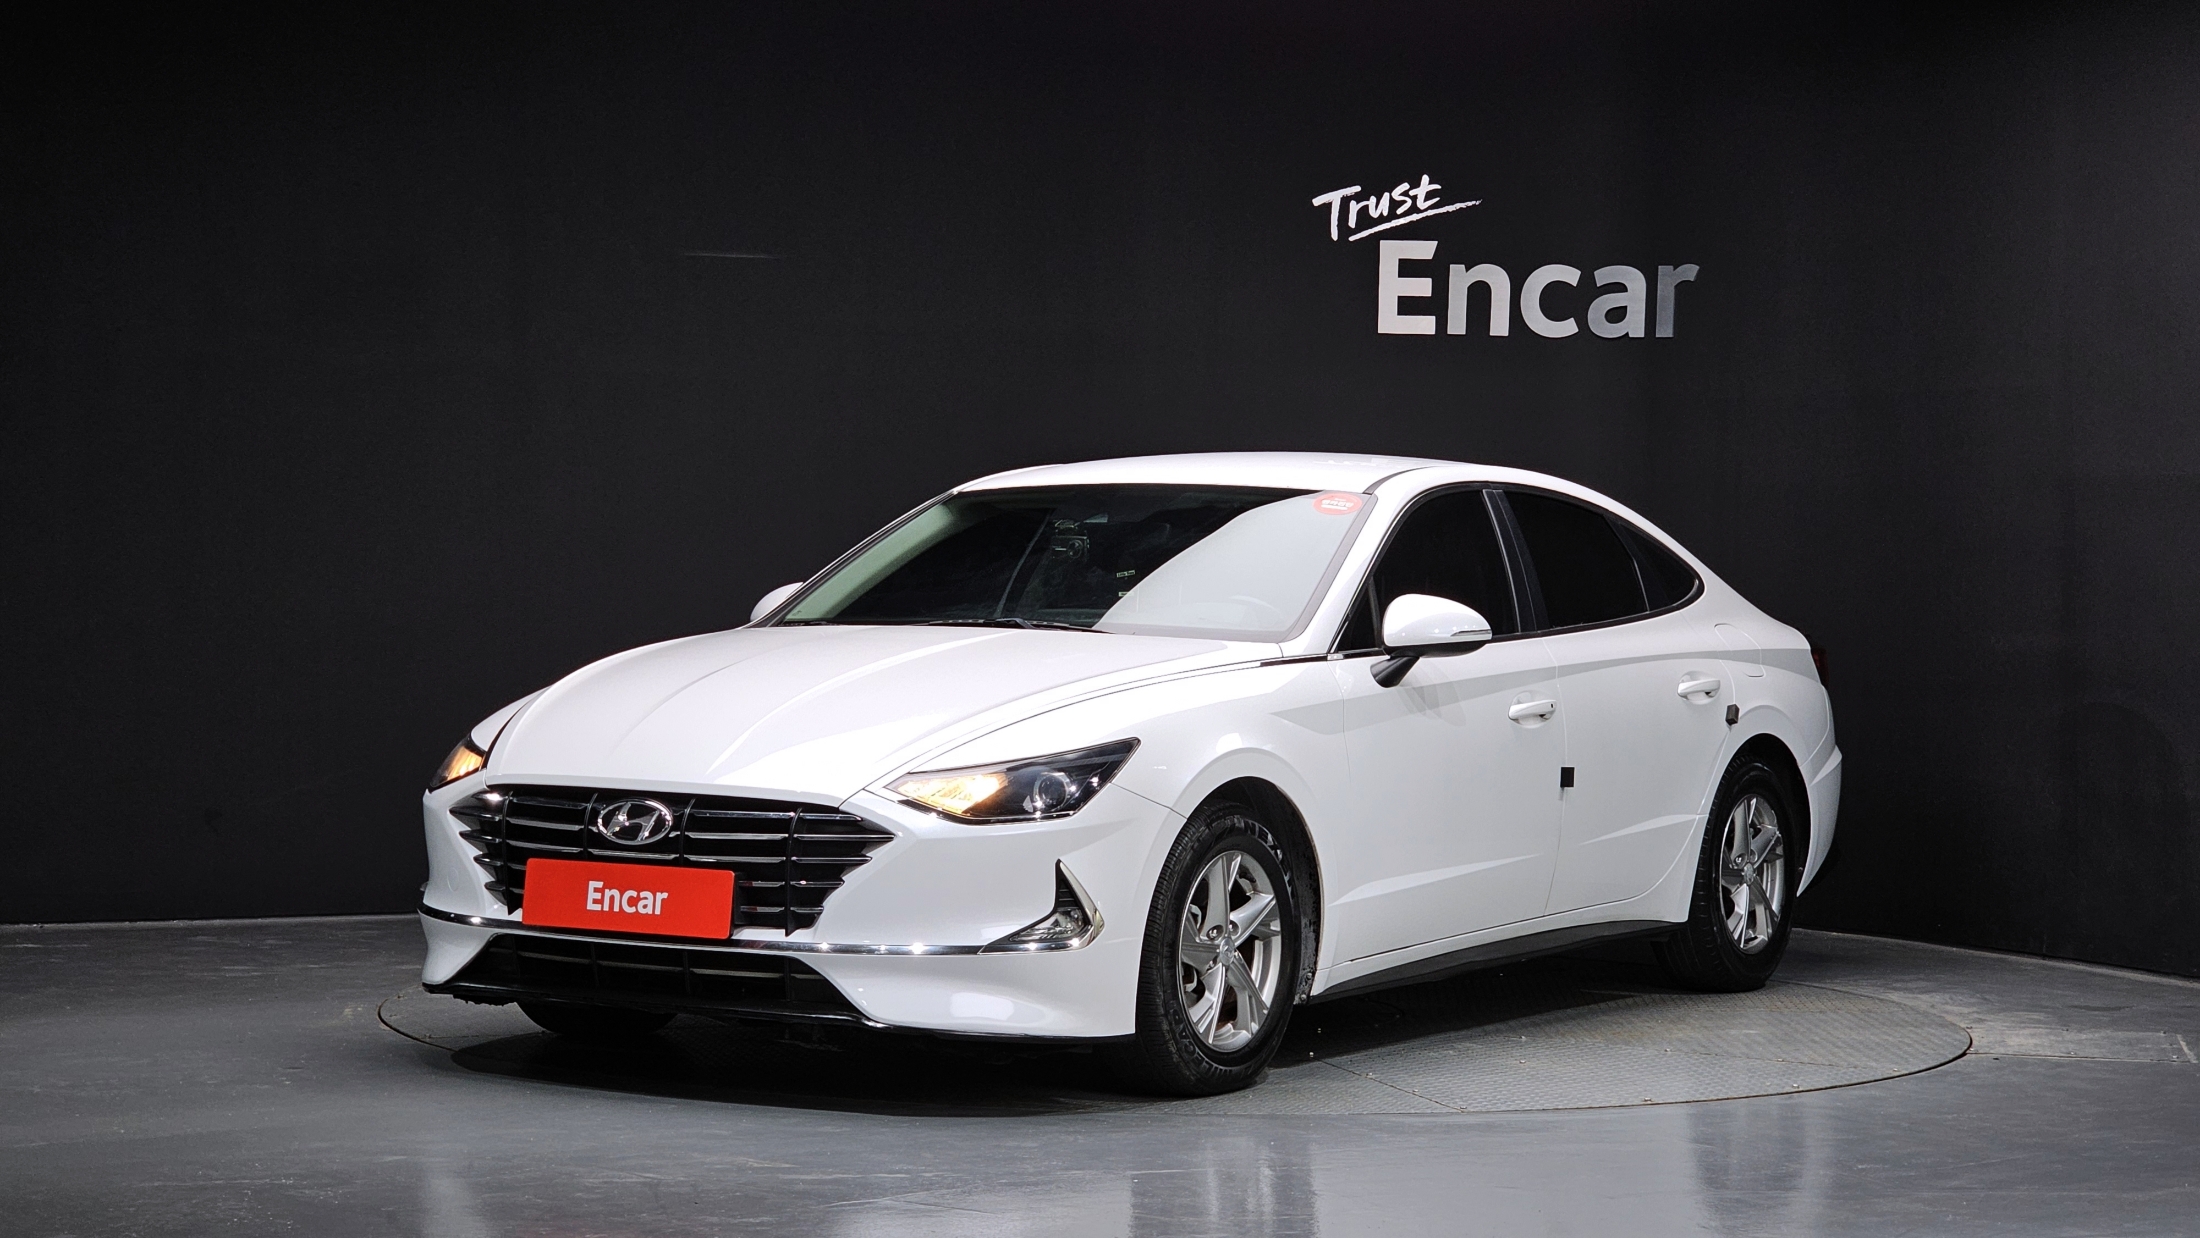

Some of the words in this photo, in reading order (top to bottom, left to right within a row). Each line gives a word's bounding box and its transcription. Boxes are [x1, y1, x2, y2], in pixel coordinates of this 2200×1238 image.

[1312, 174, 1442, 241] Trust
[1377, 239, 1701, 339] Encar
[1243, 819, 1295, 900] NEXEN
[586, 880, 669, 915] Encar
